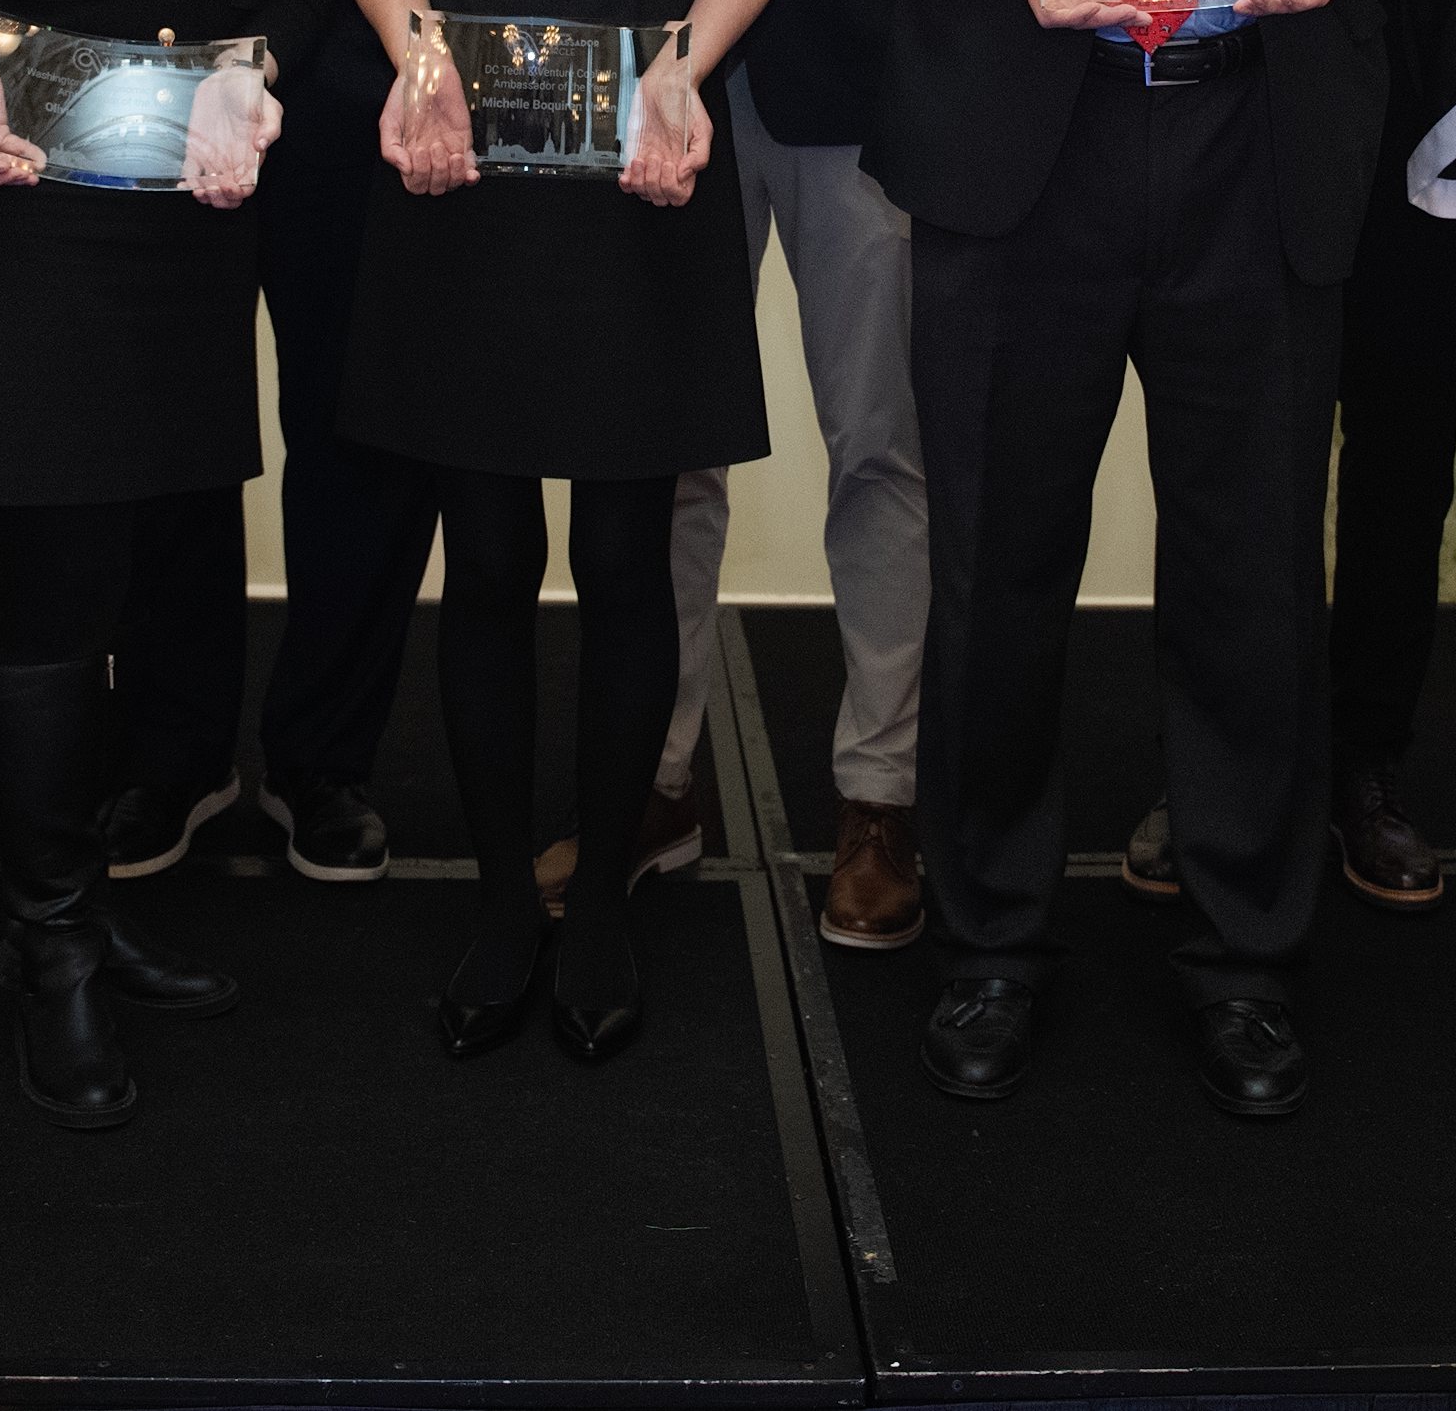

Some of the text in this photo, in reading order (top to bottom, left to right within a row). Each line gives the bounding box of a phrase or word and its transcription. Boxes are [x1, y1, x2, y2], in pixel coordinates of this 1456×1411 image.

[539, 38, 600, 48] AASSADOR
[484, 63, 500, 75] DC
[501, 65, 525, 77] Tech
[26, 67, 82, 88] Washington
[493, 79, 556, 91] Ambassador
[481, 97, 530, 110] Michelle
[532, 99, 583, 113] Boquiren
